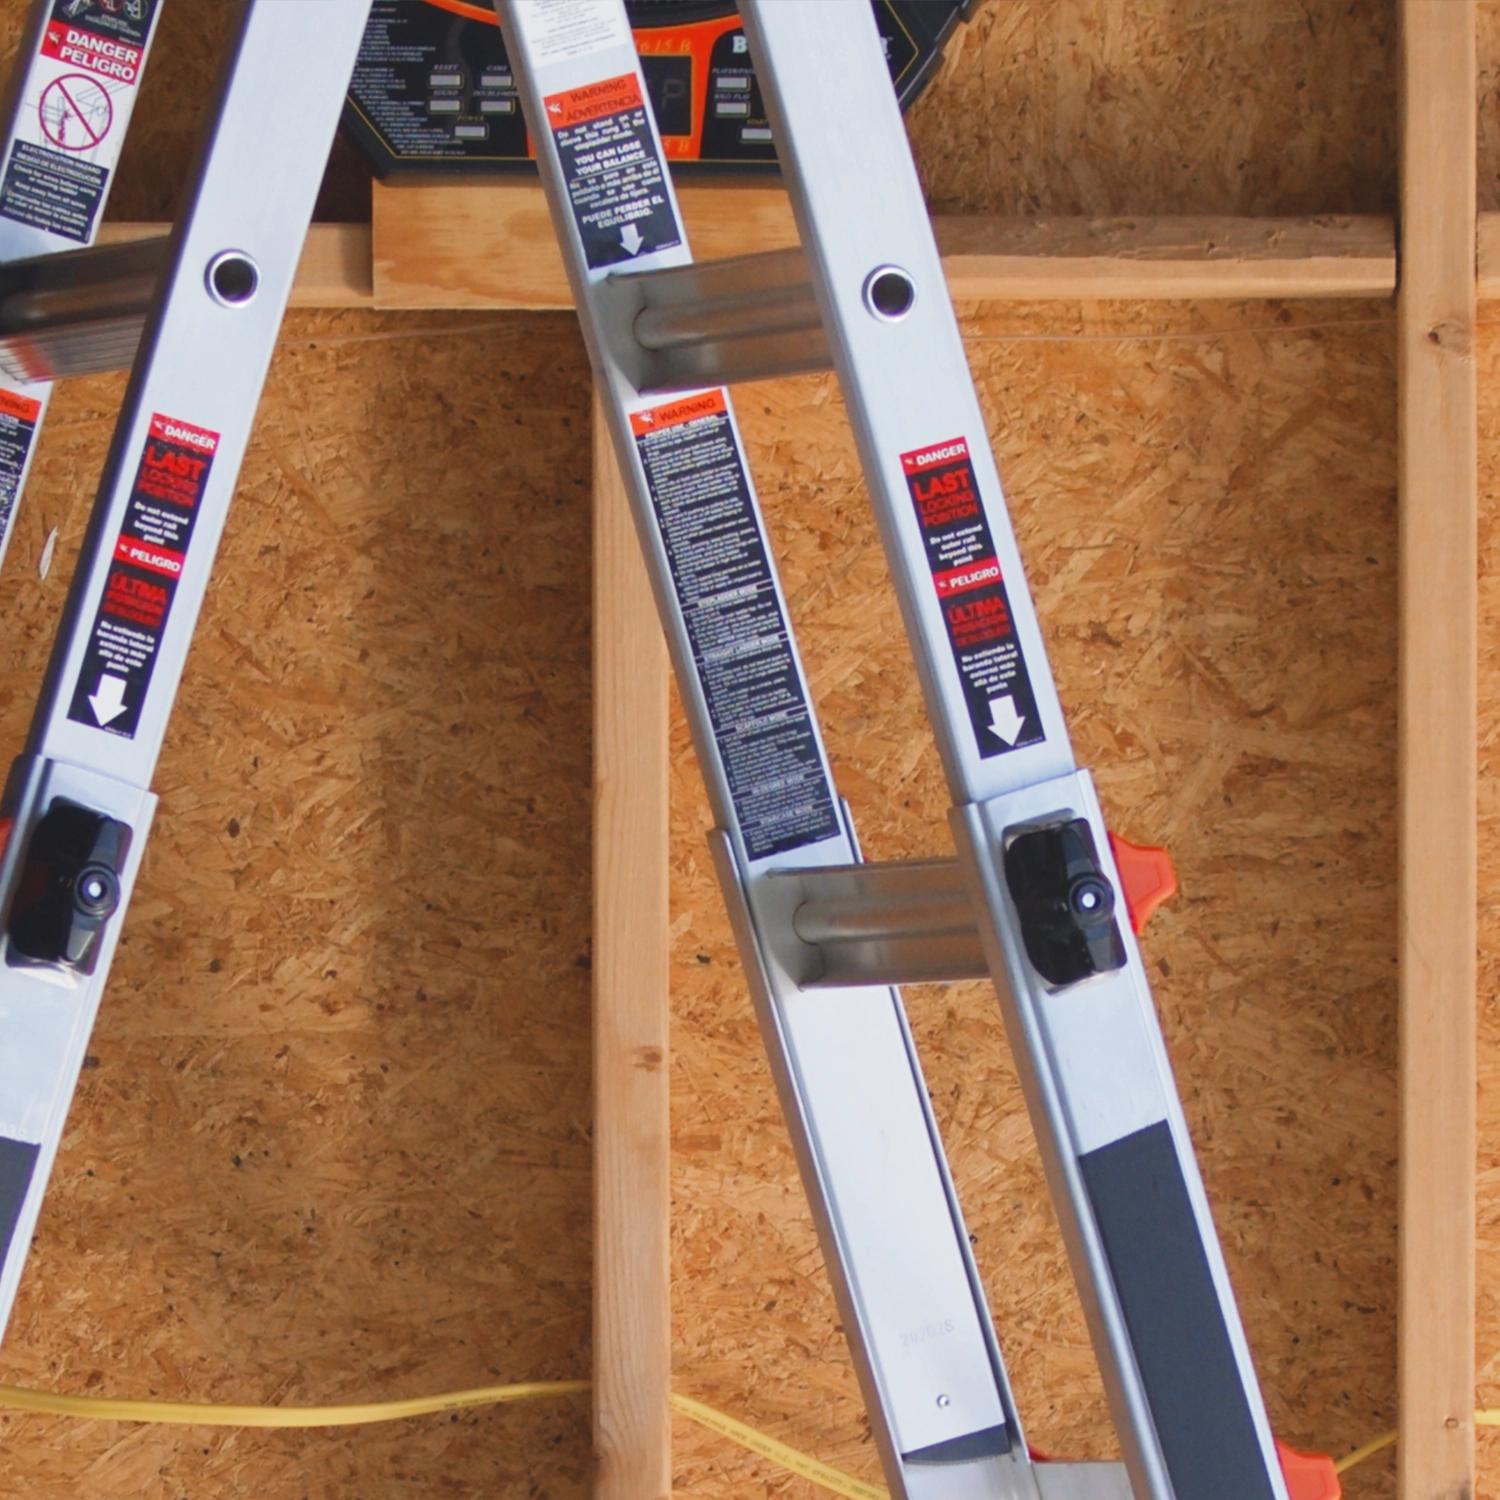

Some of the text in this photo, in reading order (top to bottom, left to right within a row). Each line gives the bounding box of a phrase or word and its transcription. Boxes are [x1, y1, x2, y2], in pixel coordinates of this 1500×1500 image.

[64, 29, 140, 65] DANGER
[58, 45, 136, 81] PELIGRO
[569, 78, 627, 103] WARNING
[565, 92, 641, 123] ADVERTENCIA
[574, 140, 641, 166] YOU CAN LOSE
[574, 149, 646, 176] YOUR BALANCE
[581, 208, 614, 224] PUEDE
[613, 197, 651, 215] PERDER
[660, 398, 716, 422] WARNING
[163, 424, 216, 450] DANGER
[143, 444, 207, 482] LAST
[915, 442, 966, 466] DANGER
[912, 467, 973, 502] LAST
[129, 547, 182, 573] PELIGRO
[949, 565, 1000, 588] PELIGRO
